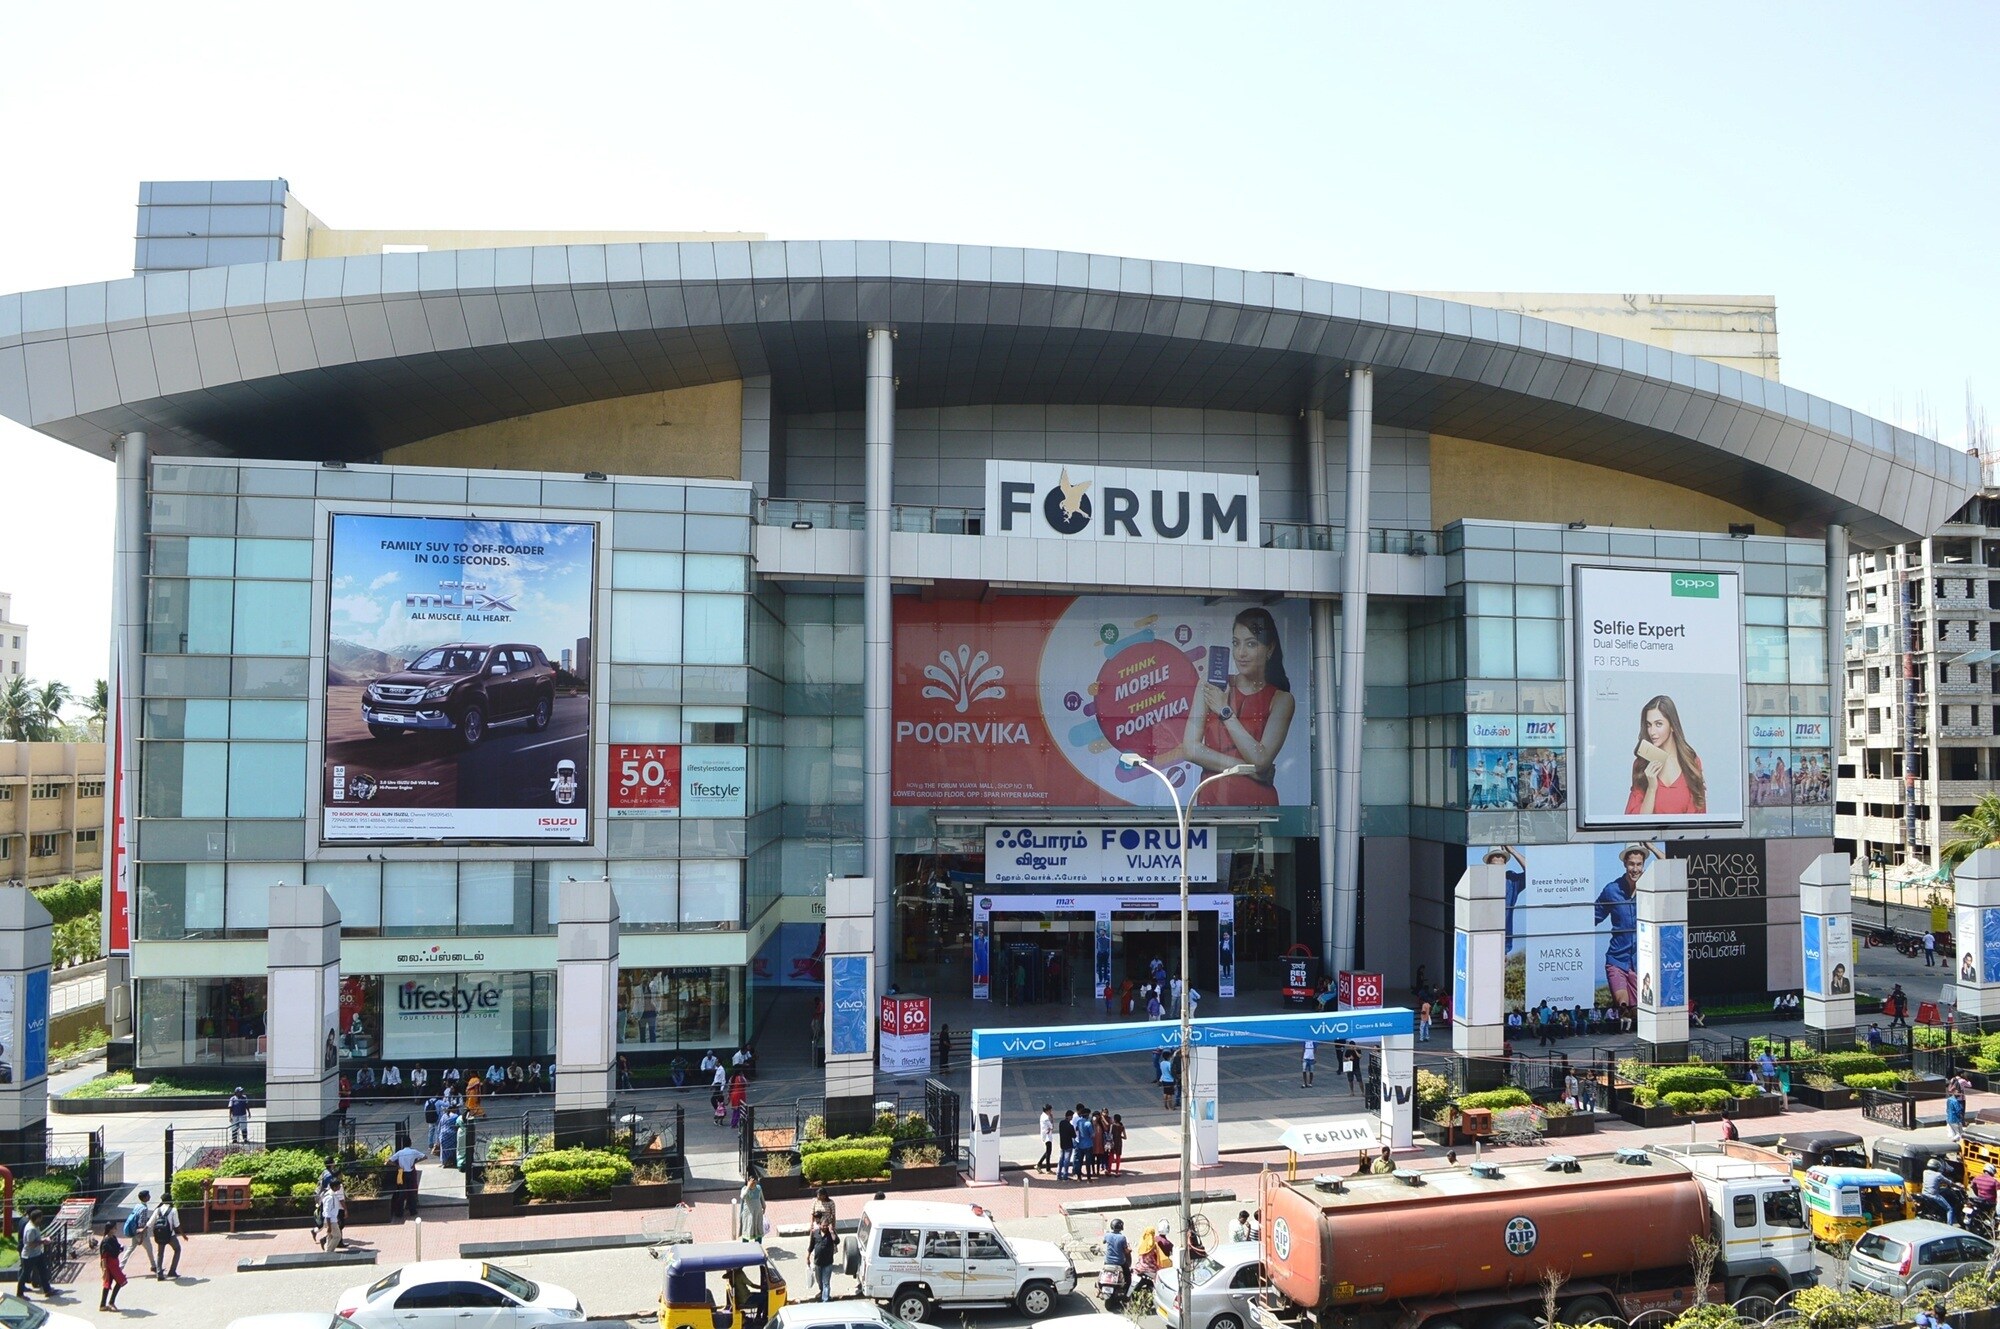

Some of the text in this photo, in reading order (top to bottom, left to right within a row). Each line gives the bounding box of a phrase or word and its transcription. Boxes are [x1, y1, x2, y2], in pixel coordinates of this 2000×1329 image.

[1001, 481, 1247, 542] FORUM
[381, 540, 544, 556] FAMILY SUV TO OFF-ROADER
[414, 554, 510, 566] IN 0.0 SECONDS.
[439, 580, 486, 590] ISUZU
[1675, 578, 1714, 588] oppo
[411, 612, 427, 620] ALL
[466, 614, 480, 622] ALL
[1593, 620, 1685, 640] Selfie Expert
[1593, 639, 1673, 651] Dual Selfie Camera
[1118, 656, 1158, 679] THINK
[1594, 656, 1640, 667] F3 F3 Plus
[1114, 664, 1170, 702] MOBILE
[1128, 690, 1166, 714] THINK
[1115, 696, 1189, 740] POORVIKA
[896, 722, 1030, 744] POORVIKA
[1526, 722, 1556, 734] max
[1796, 723, 1821, 734] max
[620, 749, 666, 759] FLAT
[620, 761, 671, 786] 50%
[687, 765, 745, 773] lifestylestores.com
[550, 778, 560, 791] 7
[690, 782, 740, 798] lifestyle
[620, 787, 666, 796] OFF
[538, 818, 577, 826] ISUZU
[996, 828, 1088, 851] ஃபோரம்
[1102, 829, 1208, 850] FORUM
[1016, 852, 1068, 870] விஜயா
[1127, 855, 1182, 868] VIJAYA
[1554, 878, 1578, 886] through
[1687, 876, 1760, 898] PENCER
[1540, 949, 1581, 958] MARKS &
[1538, 961, 1583, 972] SPENCER
[398, 980, 499, 1013] lifestyle
[836, 1000, 863, 1008] vivo
[883, 999, 895, 1008] SALE
[904, 1010, 926, 1024] 60%
[28, 1019, 44, 1030] vivo
[1310, 1021, 1348, 1035] vivo
[1002, 1037, 1046, 1051] vivo
[1304, 1128, 1368, 1144] FORUM
[1508, 1231, 1534, 1244] AIP
